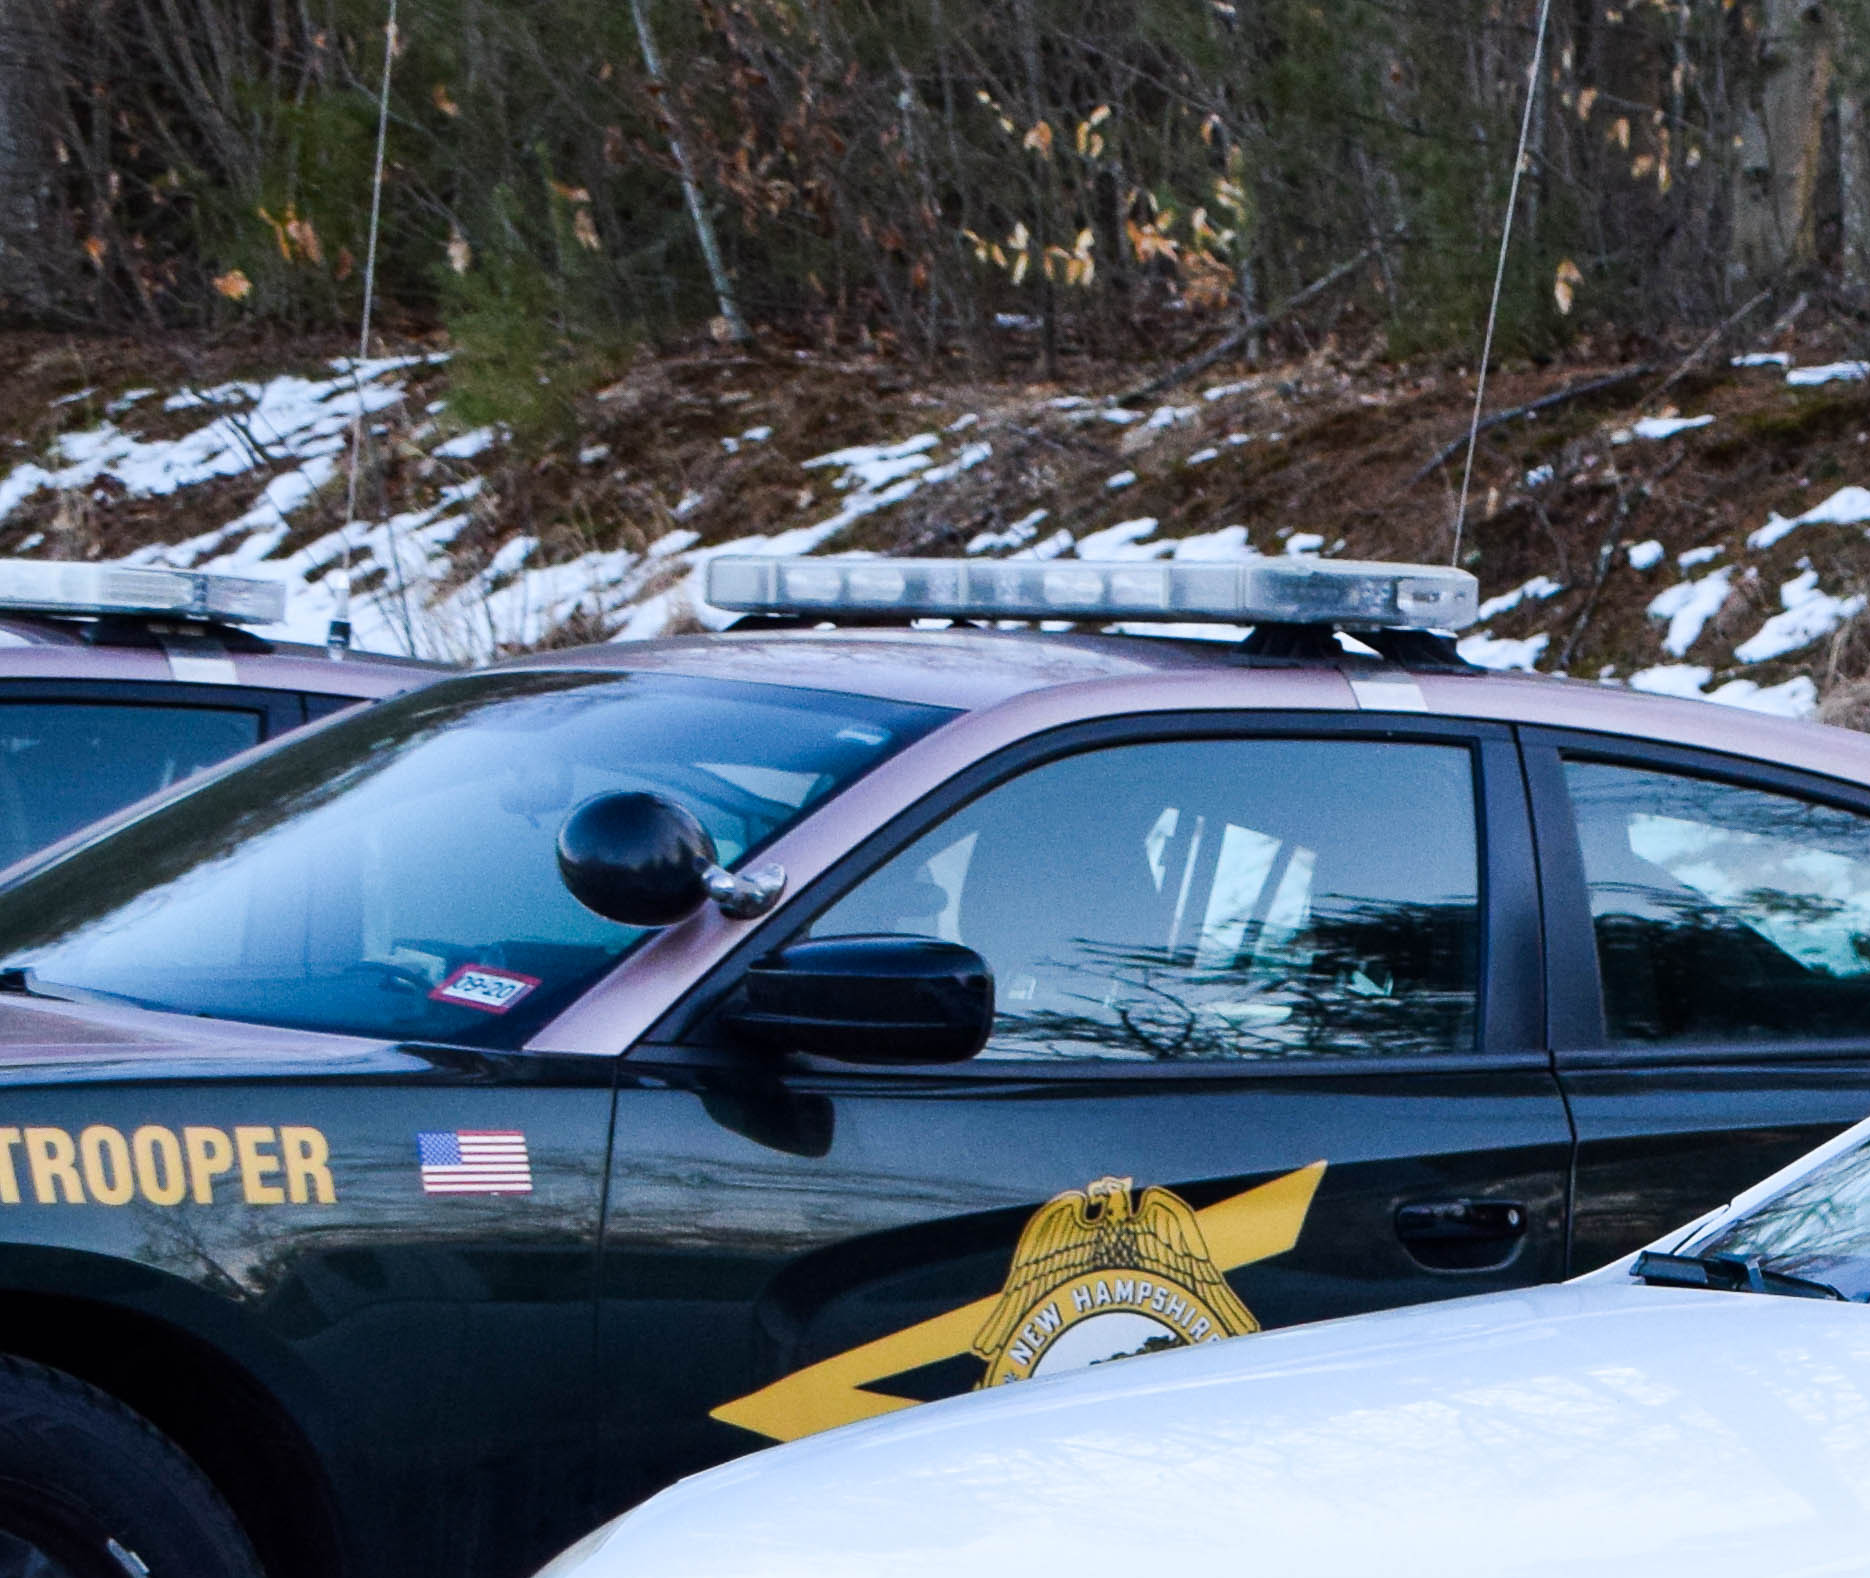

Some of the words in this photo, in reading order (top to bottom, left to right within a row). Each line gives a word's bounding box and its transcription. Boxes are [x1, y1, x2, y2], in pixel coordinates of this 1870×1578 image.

[453, 976, 516, 999] 09-20
[0, 1125, 336, 1205] TROOPER
[1008, 1302, 1063, 1366] NEW
